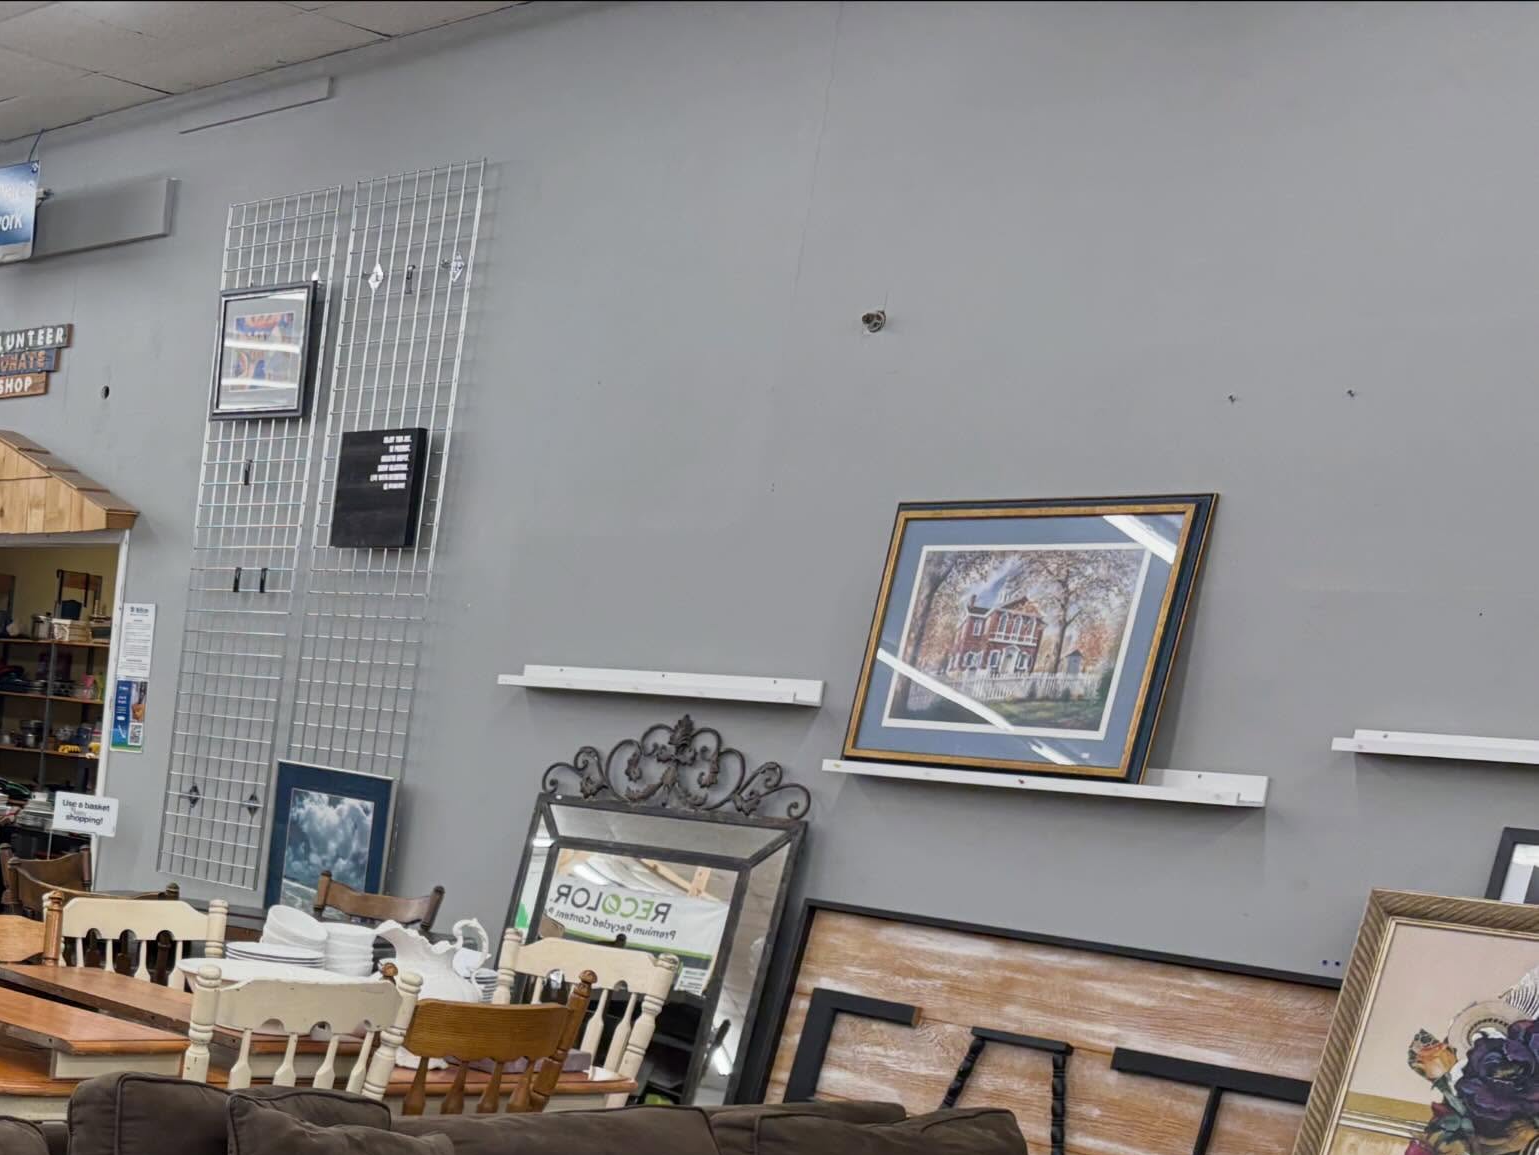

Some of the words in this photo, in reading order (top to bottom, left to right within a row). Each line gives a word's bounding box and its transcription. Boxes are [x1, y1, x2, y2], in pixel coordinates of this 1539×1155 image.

[62, 799, 77, 808] Use
[85, 801, 110, 812] basket
[65, 813, 104, 826] shopping!
